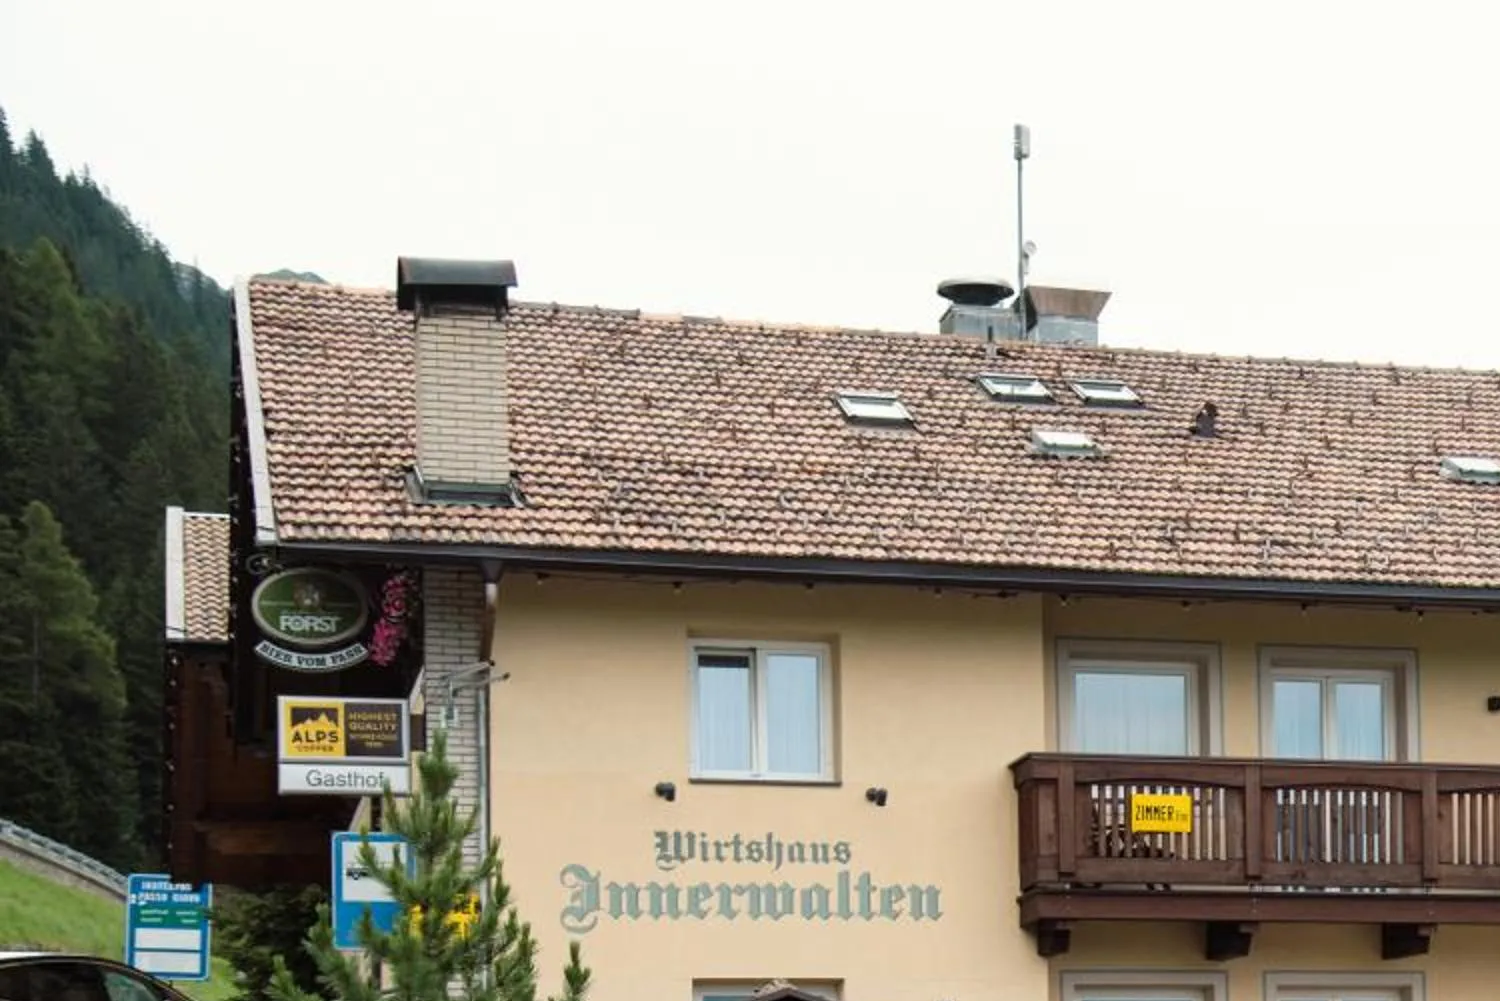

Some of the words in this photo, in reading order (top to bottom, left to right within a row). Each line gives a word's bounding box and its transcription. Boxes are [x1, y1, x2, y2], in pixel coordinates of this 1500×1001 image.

[279, 615, 343, 632] FORST
[260, 643, 292, 663] BIER
[296, 655, 326, 667] VOM
[349, 722, 398, 731] QUALITY
[291, 730, 339, 743] ALPS
[305, 769, 385, 788] Gasthof
[1135, 804, 1175, 821] ZIMMER
[653, 829, 852, 871] Wirtshaus
[559, 863, 943, 934] Innerwalten
